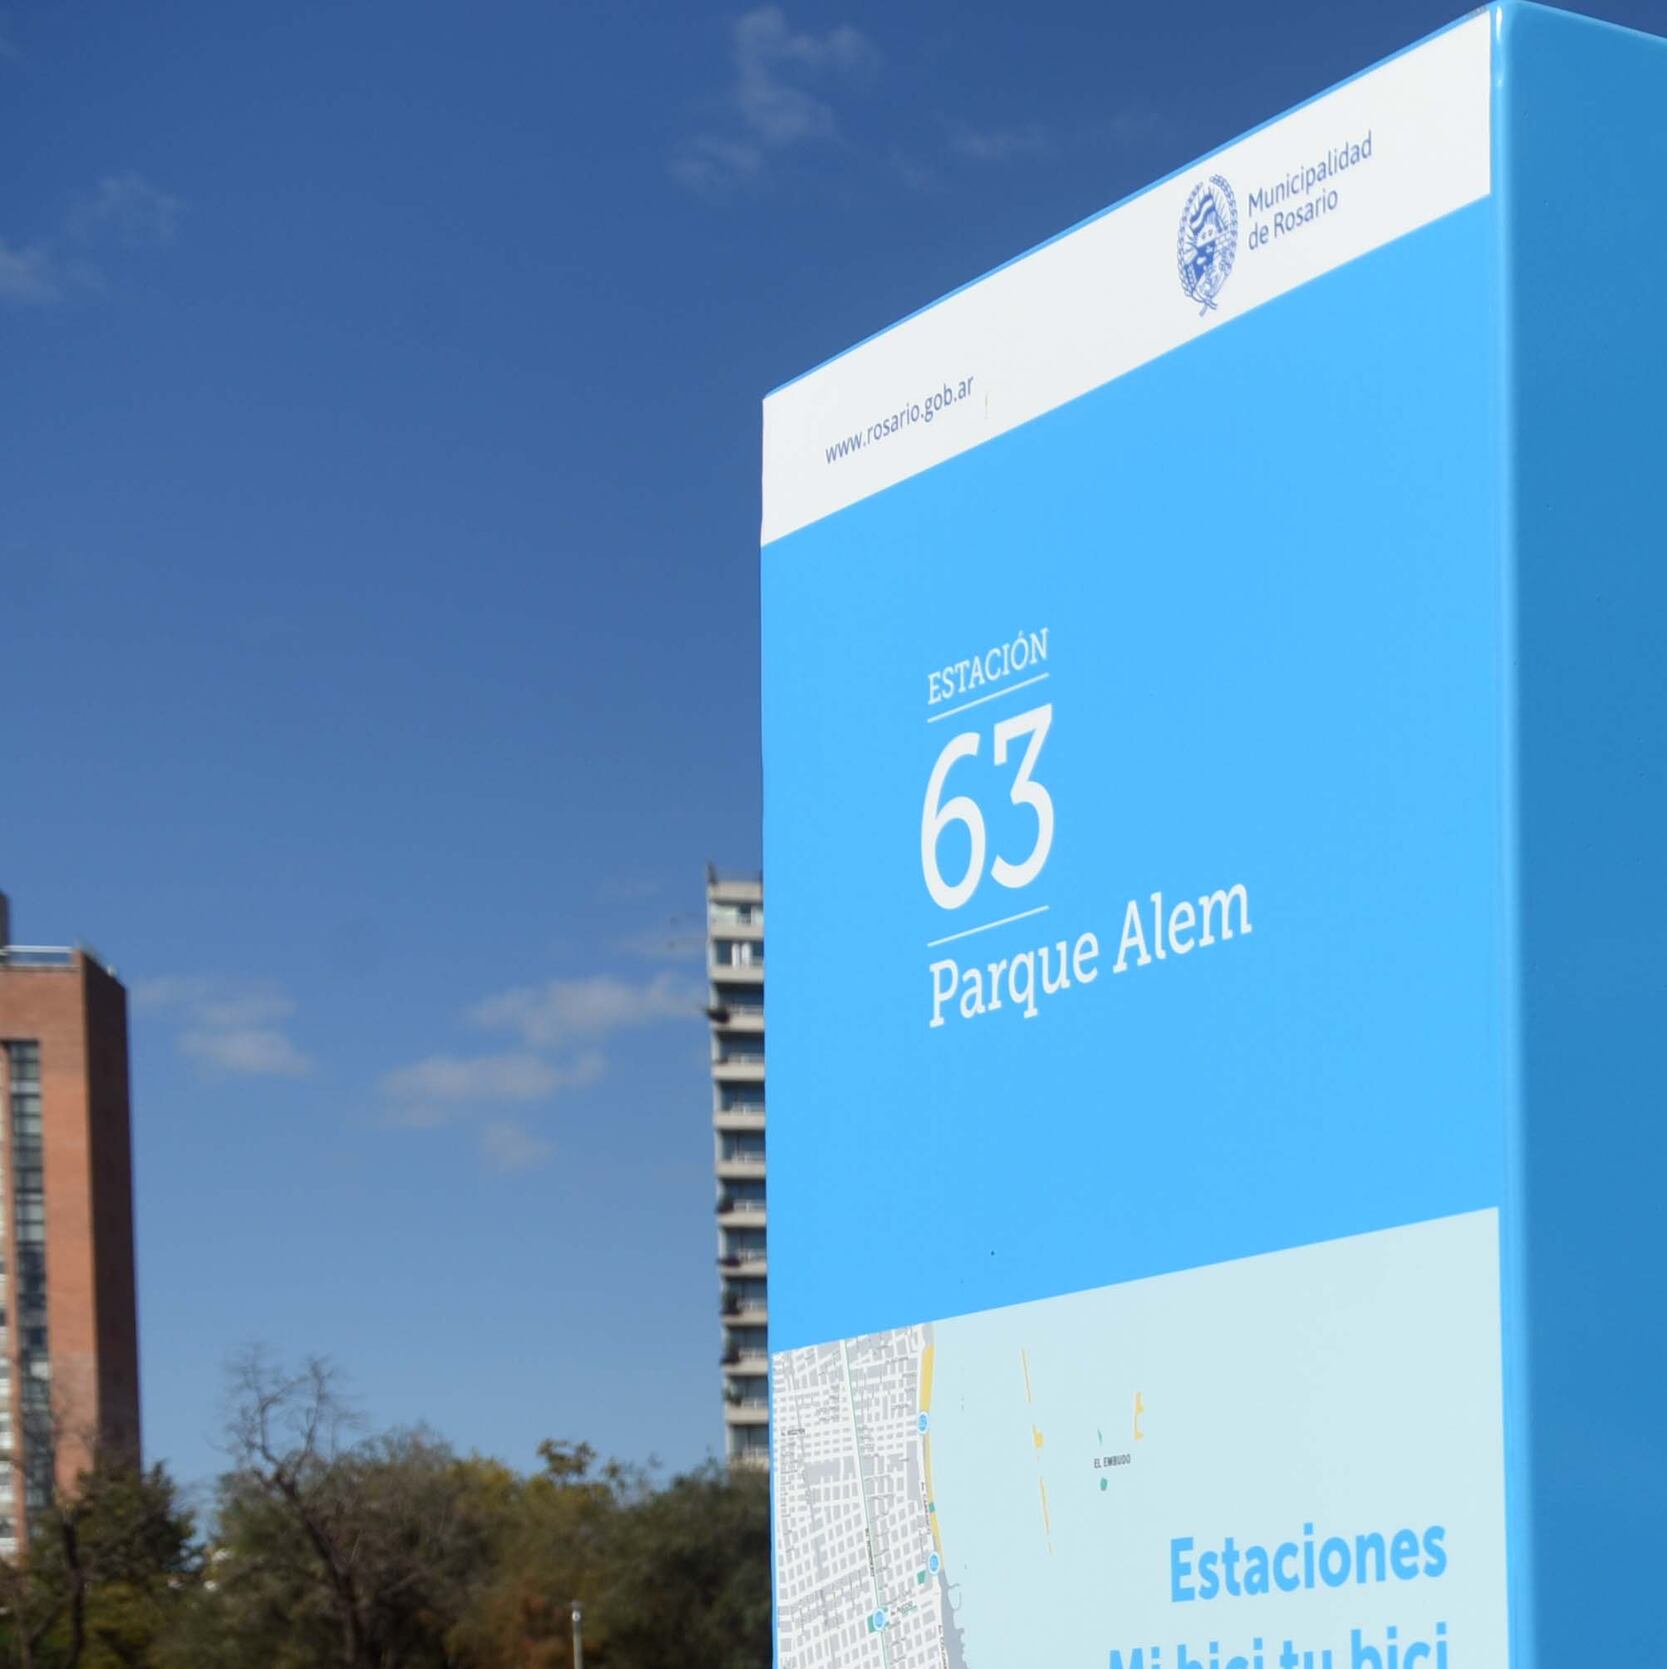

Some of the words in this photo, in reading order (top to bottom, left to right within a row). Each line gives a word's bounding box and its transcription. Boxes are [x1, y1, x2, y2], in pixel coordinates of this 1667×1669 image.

[1248, 130, 1373, 218] Municipalidad
[1248, 219, 1269, 251] de
[1272, 189, 1340, 242] Rosario
[825, 374, 974, 464] www.rosario.gob.ar
[927, 628, 1049, 706] ESTACIÓN
[920, 703, 1055, 911] 63
[928, 932, 1099, 1028] Parque
[1112, 882, 1253, 974] Alem
[1103, 1454, 1131, 1467] EMBUDO
[1170, 1523, 1448, 1602] Estaciones
